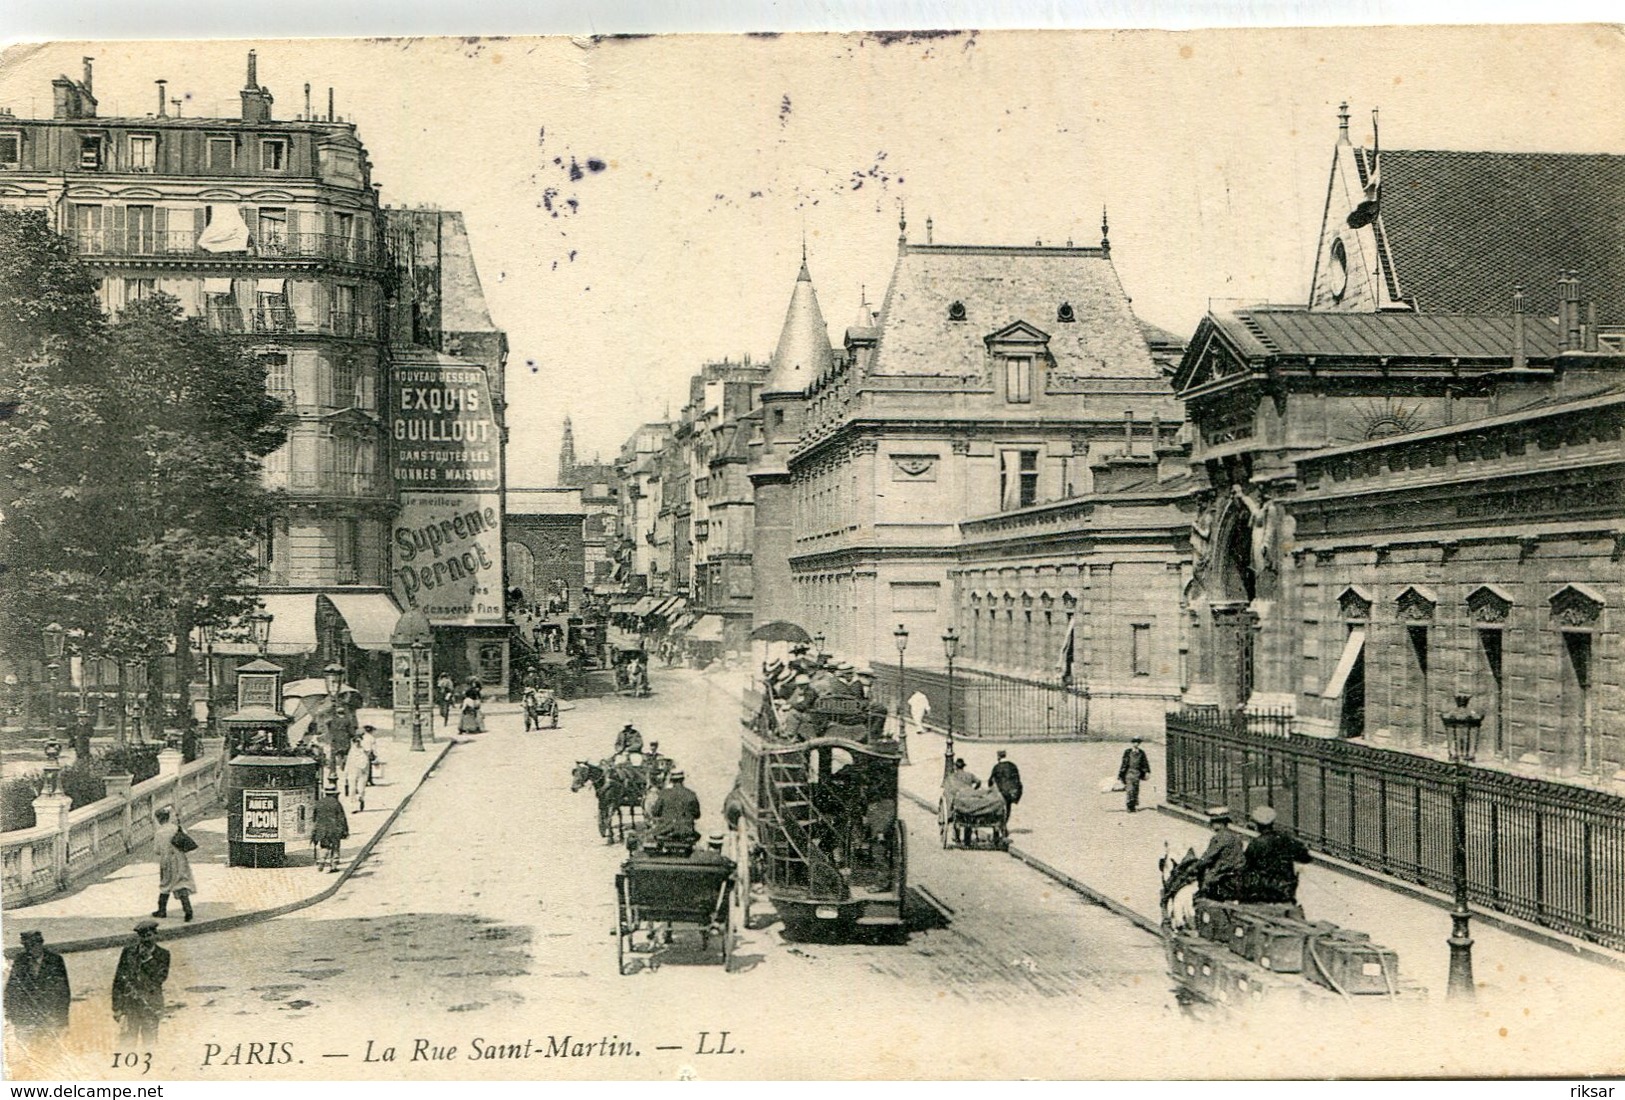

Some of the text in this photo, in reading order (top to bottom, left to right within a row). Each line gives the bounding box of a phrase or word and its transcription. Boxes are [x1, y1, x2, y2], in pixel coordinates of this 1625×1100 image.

[401, 387, 479, 414] EXQUIS
[394, 418, 490, 442] GUILLOUT
[400, 450, 490, 462] DANS TOUTES LES
[394, 467, 494, 481] BONNES MAISONS
[394, 506, 498, 562] Suprême
[393, 541, 493, 610] Pernot
[469, 585, 489, 597] des
[422, 603, 500, 615] desserts fins
[248, 799, 274, 811] AMER
[245, 810, 278, 829] PICON
